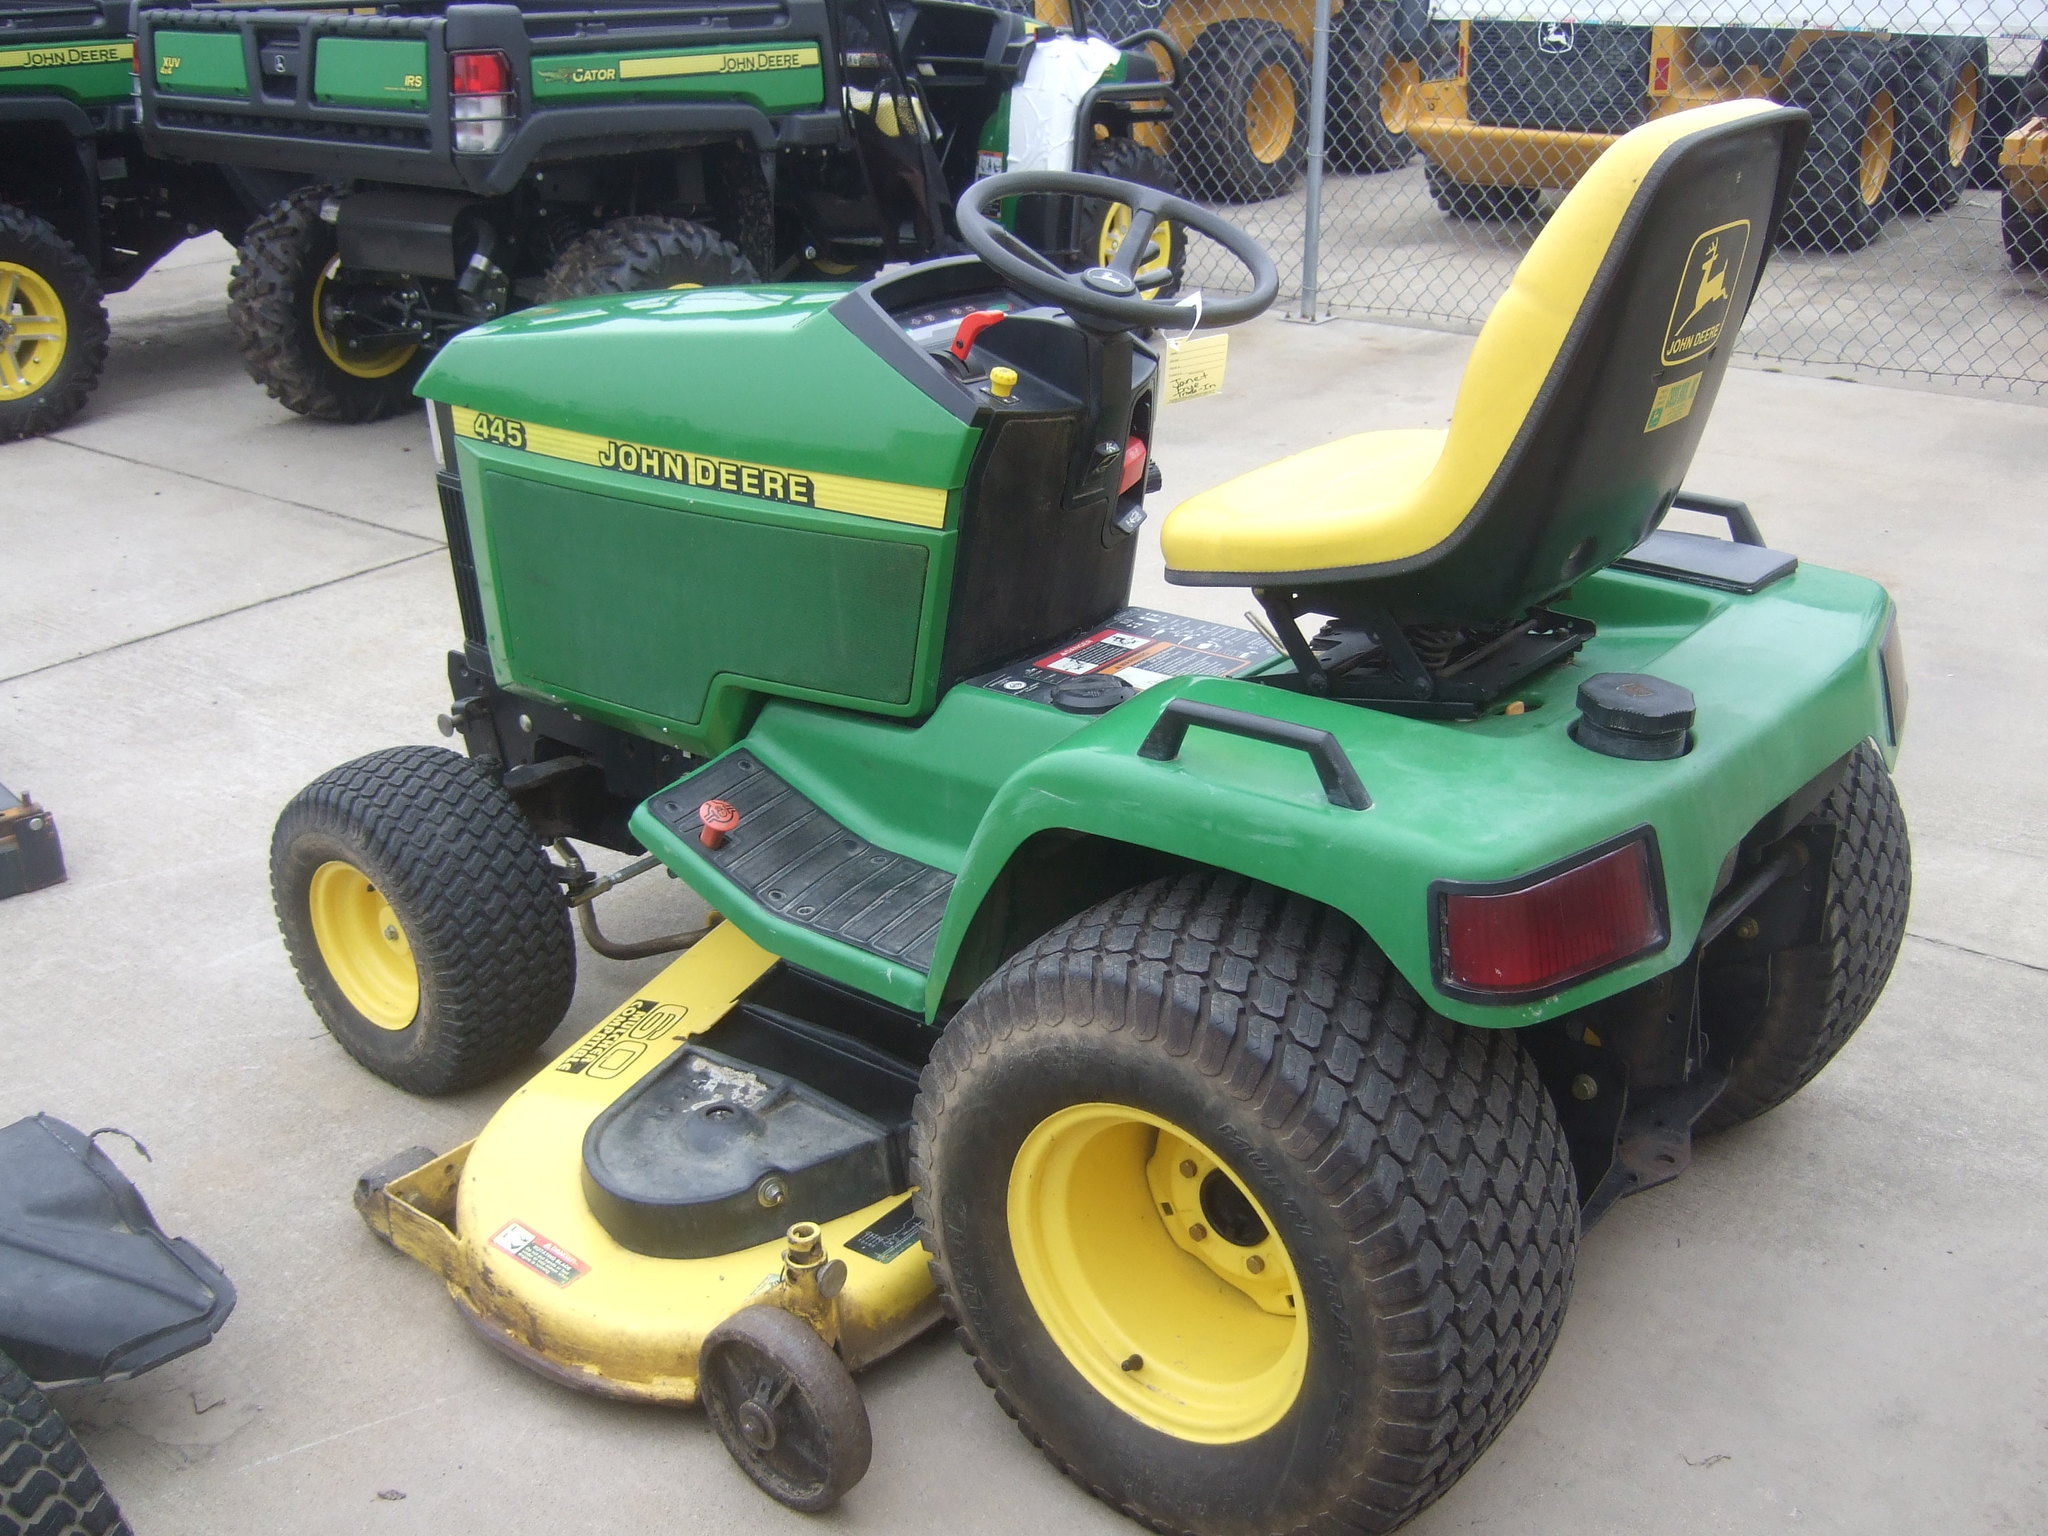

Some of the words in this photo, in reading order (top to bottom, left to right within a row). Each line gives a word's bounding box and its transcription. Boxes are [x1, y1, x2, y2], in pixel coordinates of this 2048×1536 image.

[23, 52, 66, 67] JOHN
[67, 48, 119, 63] DEERE
[162, 56, 181, 68] XUV
[720, 55, 756, 72] JOHN
[757, 53, 801, 69] DEERE
[404, 74, 423, 87] IRS
[572, 68, 616, 83] GATOR
[1666, 334, 1695, 356] JOHN
[1693, 322, 1721, 347] DEERE
[474, 414, 526, 448] 445
[599, 440, 689, 485] JOHN
[694, 457, 815, 507] DEERE
[557, 1000, 645, 1071] COMPATIBLE
[580, 1010, 648, 1063] MULCHER
[585, 1003, 689, 1079] 60
